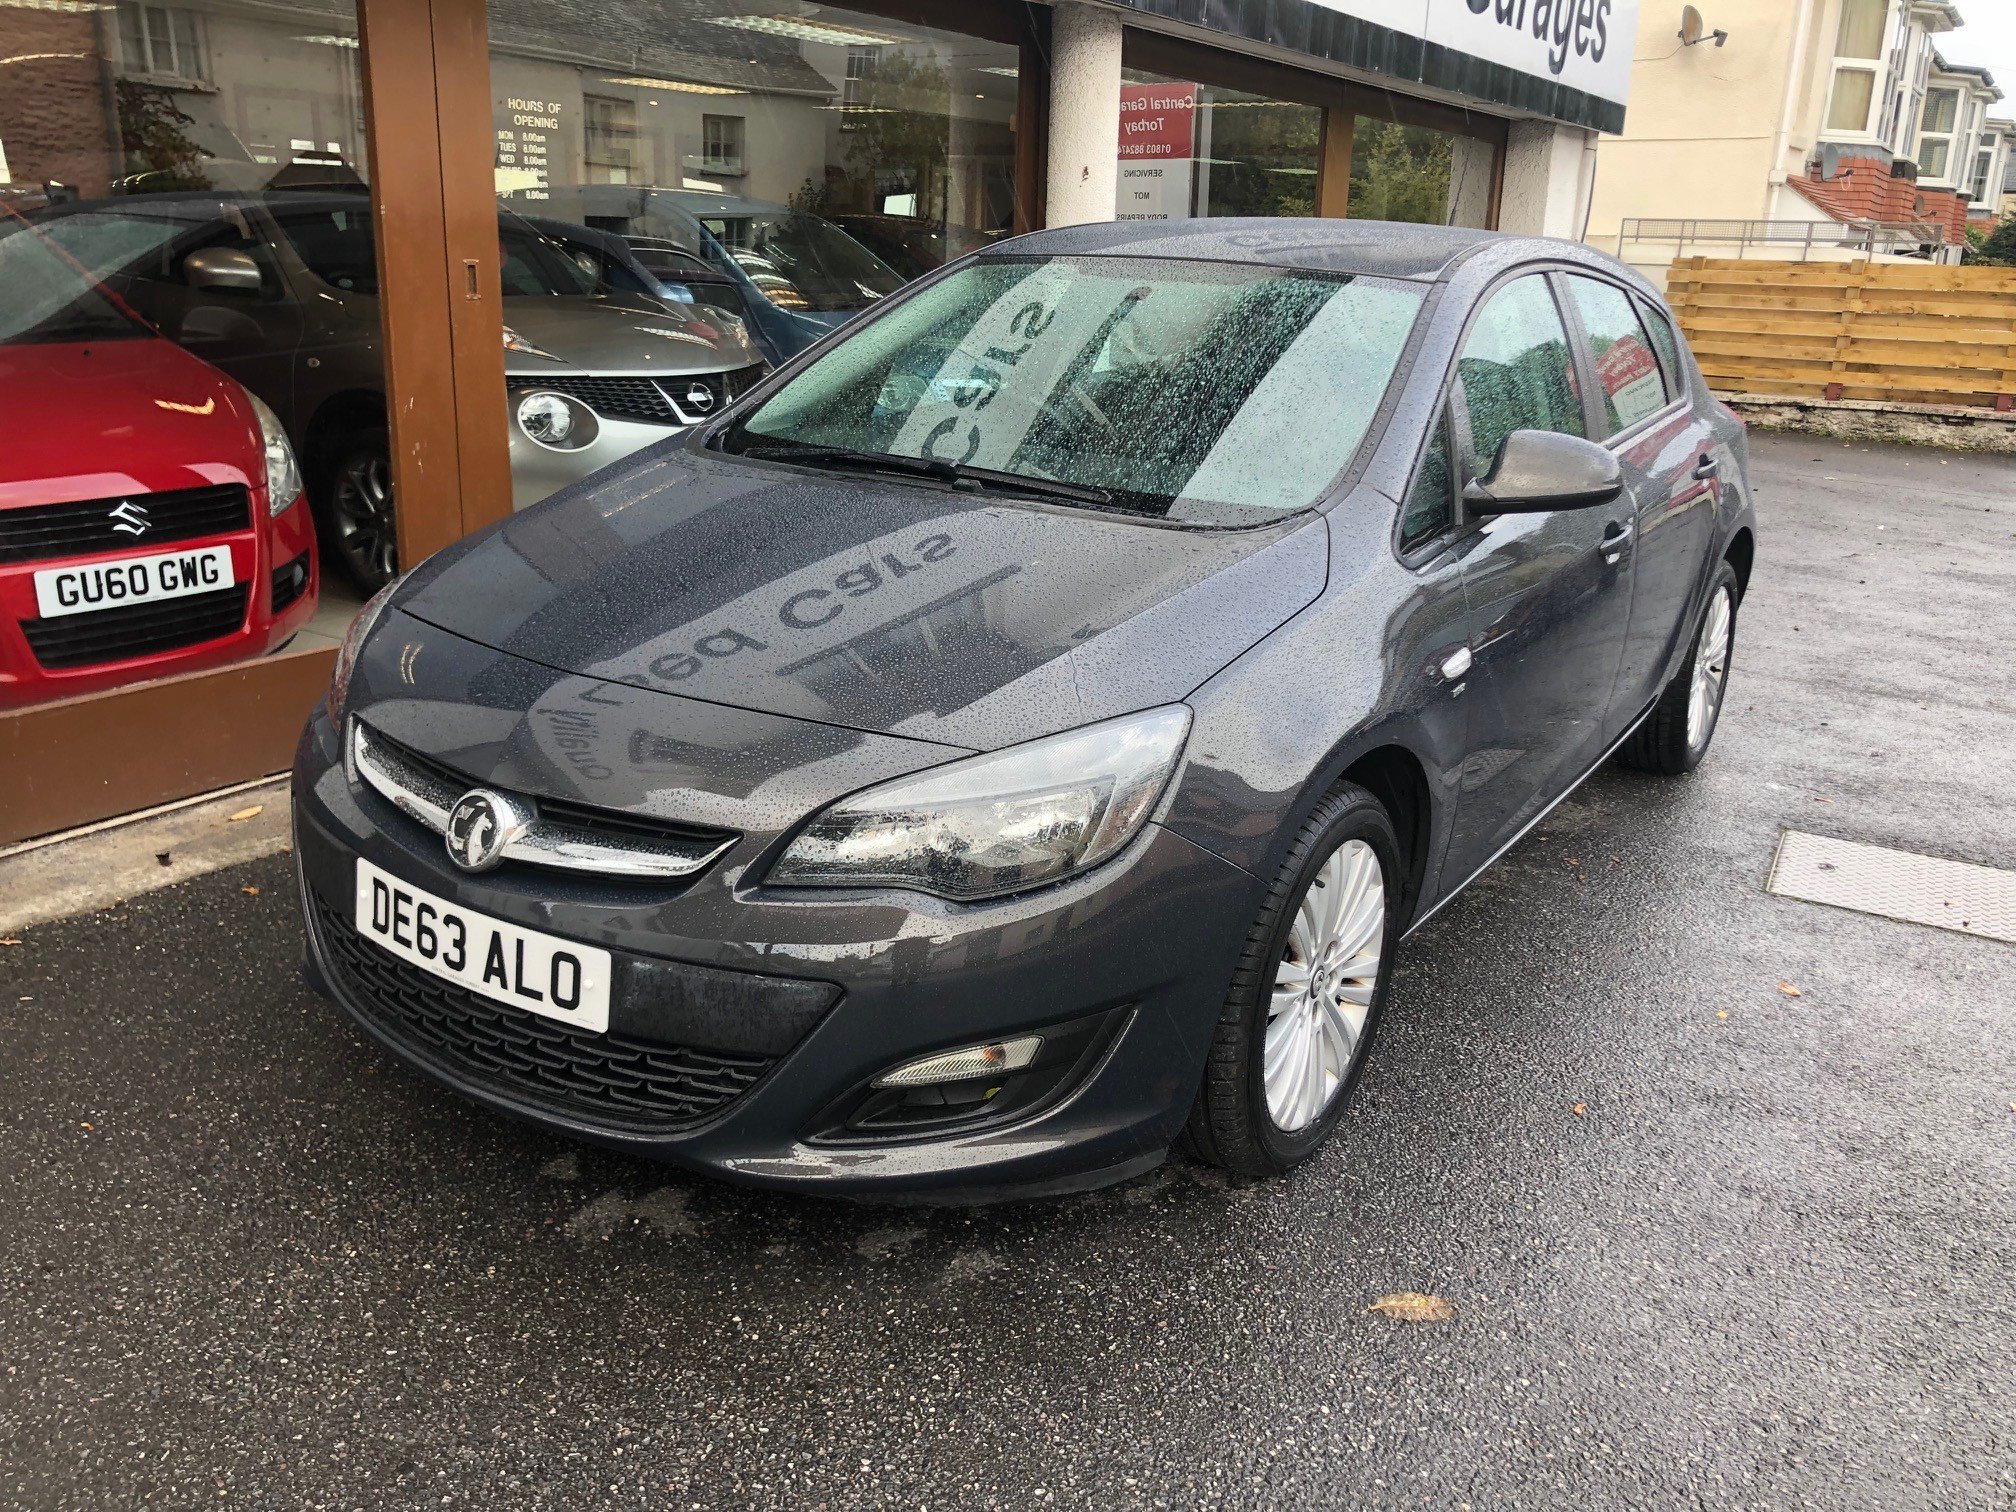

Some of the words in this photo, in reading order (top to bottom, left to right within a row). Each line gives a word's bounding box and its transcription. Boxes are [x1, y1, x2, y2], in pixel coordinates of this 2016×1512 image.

[1466, 0, 1611, 75] arages
[508, 98, 544, 113] HOURS
[548, 103, 562, 114] OF
[513, 114, 559, 130] OPENING
[498, 130, 514, 140] MON
[522, 132, 546, 142] 8.00am
[499, 142, 517, 152] TUES
[523, 144, 547, 154] 8.00am
[499, 154, 516, 164] WED
[523, 155, 548, 166] 8.00am
[56, 564, 150, 607] GU60
[159, 554, 219, 592] GWG
[372, 876, 467, 972] DE63
[482, 930, 582, 1011] ALO
